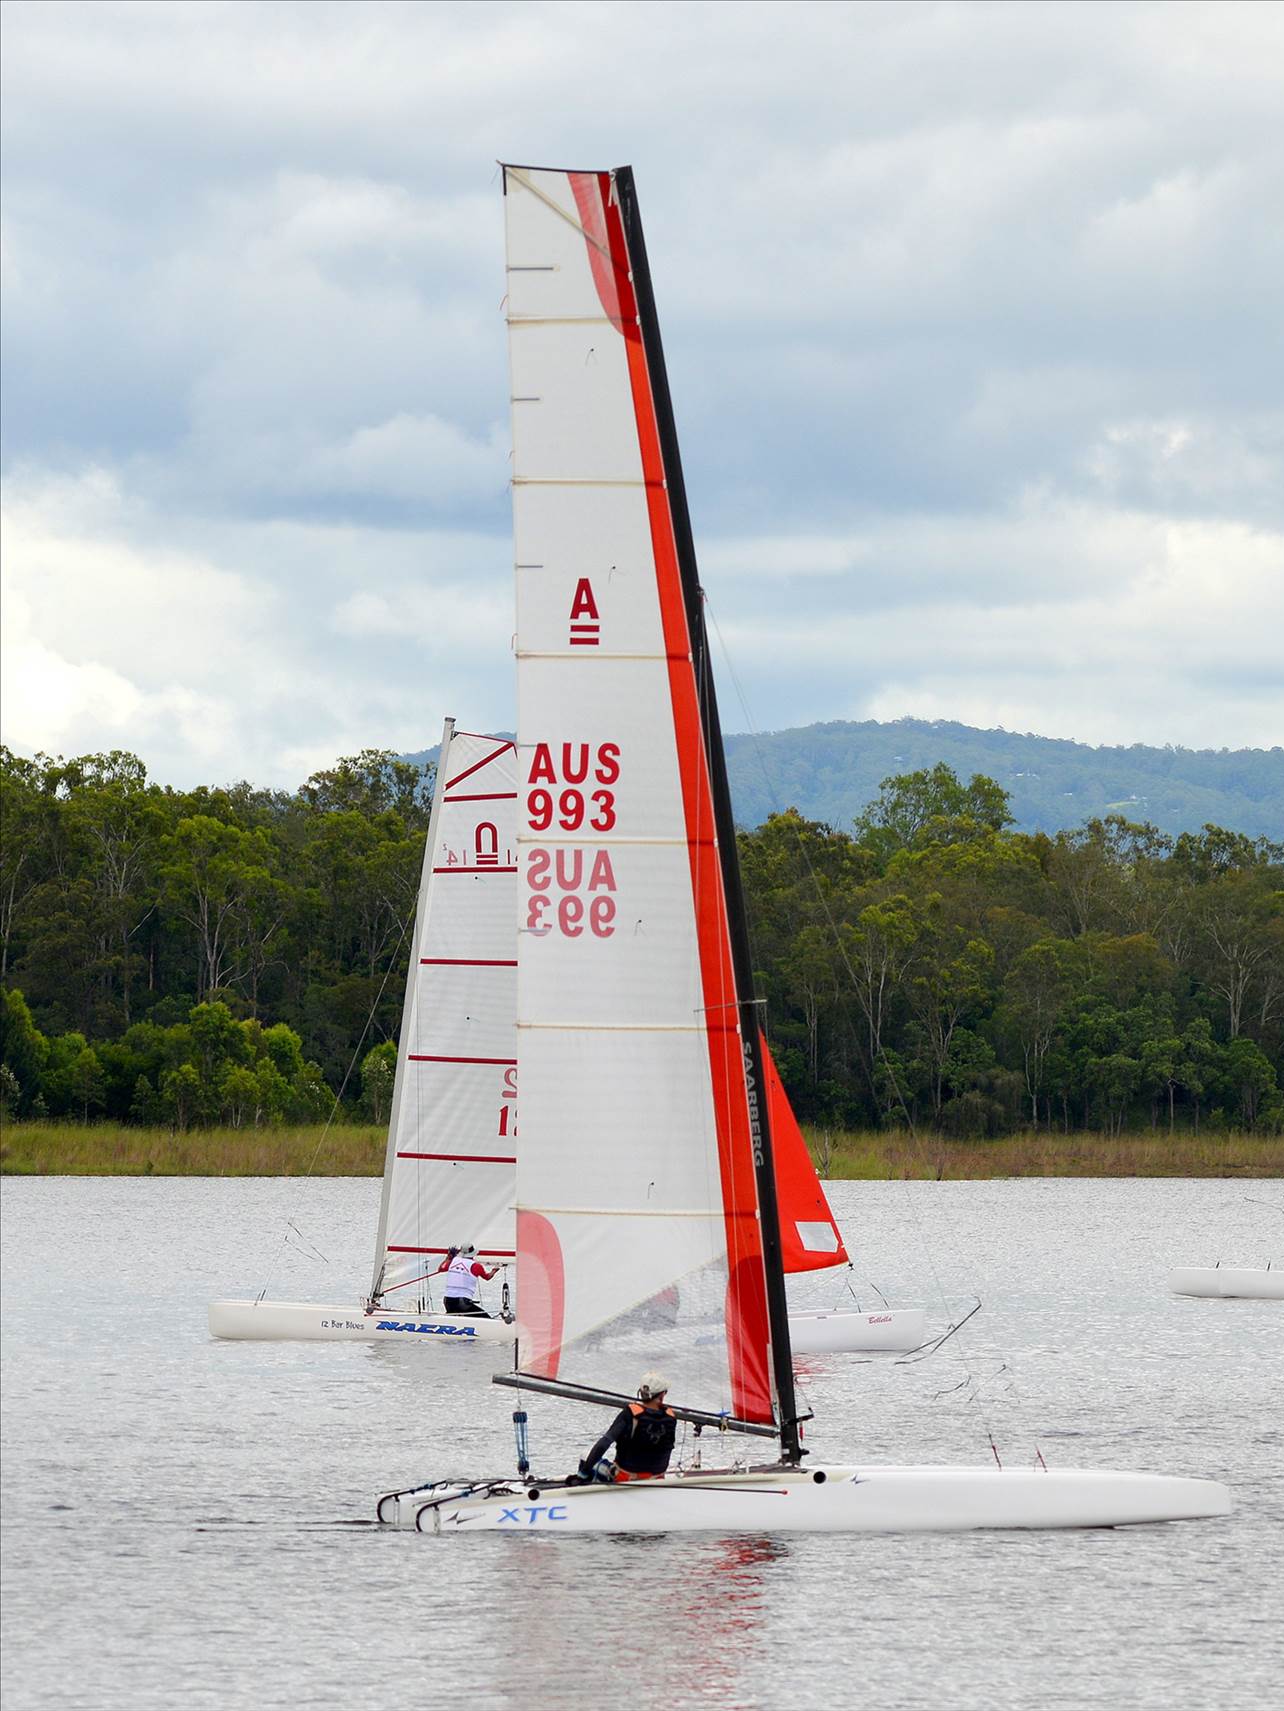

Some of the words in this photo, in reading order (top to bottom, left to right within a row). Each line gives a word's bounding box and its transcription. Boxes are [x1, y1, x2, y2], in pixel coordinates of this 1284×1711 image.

[569, 578, 600, 619] A
[527, 742, 621, 785] AUS
[527, 788, 616, 832] 993
[743, 1041, 764, 1168] SAARBERG
[497, 1505, 568, 1525] XTC
